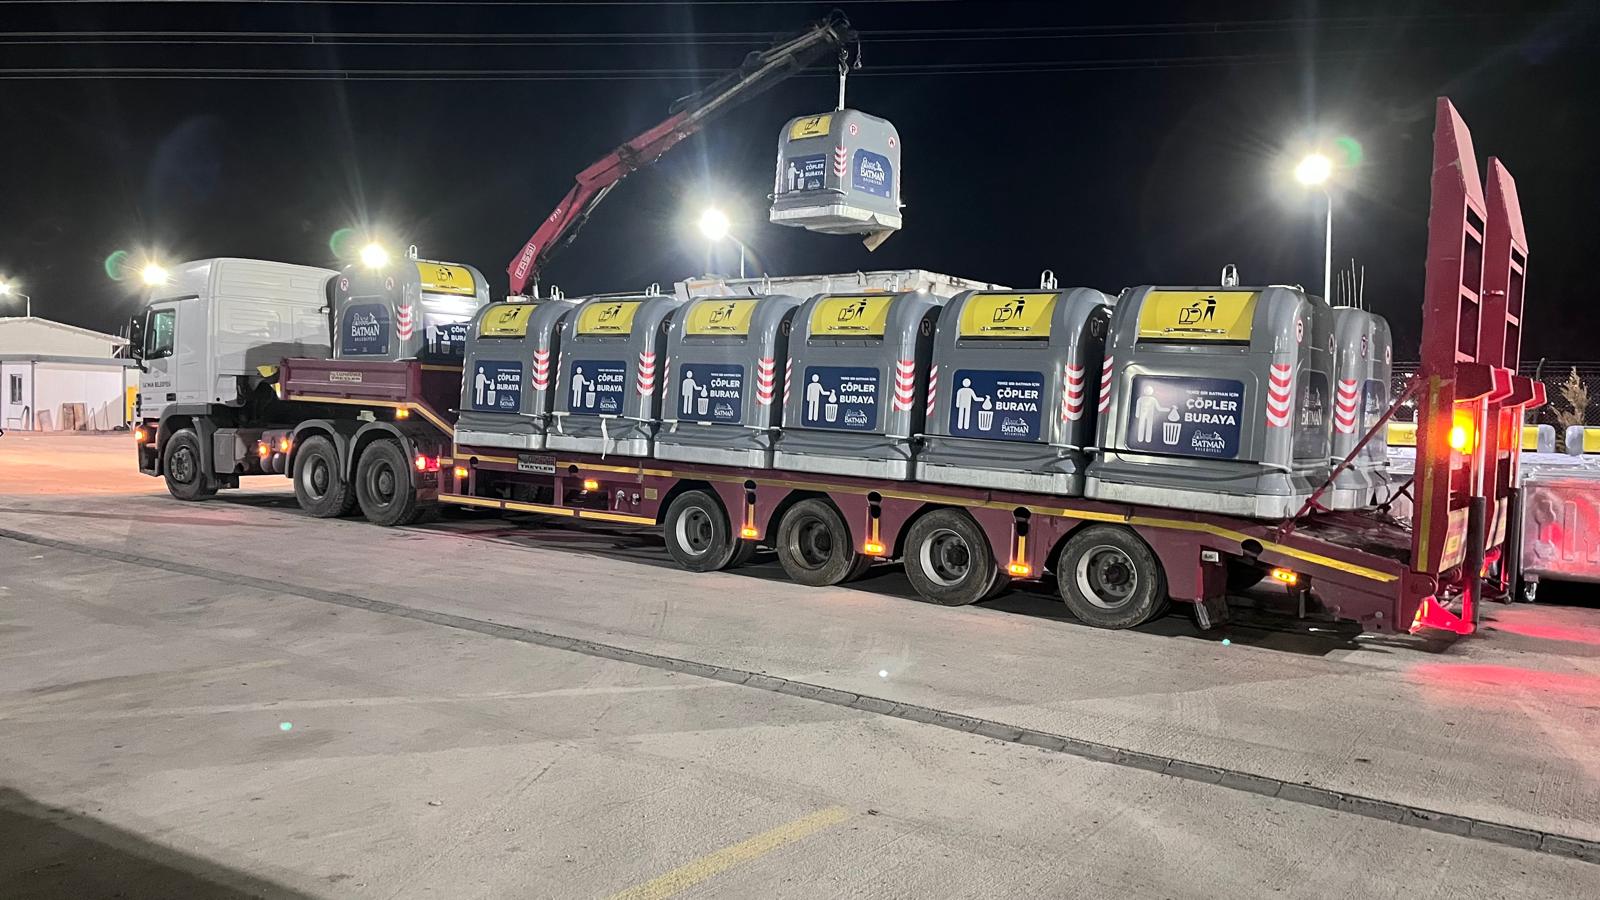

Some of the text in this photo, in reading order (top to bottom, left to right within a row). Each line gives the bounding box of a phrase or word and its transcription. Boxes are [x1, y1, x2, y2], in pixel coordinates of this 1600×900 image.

[860, 168, 885, 182] BATMAN
[351, 324, 380, 337] BATMAN
[497, 372, 520, 382] ÇÖPLER
[597, 373, 624, 383] ÇÖPLER
[710, 377, 740, 388] ÇÖPLER
[496, 383, 519, 391] BURAYA
[596, 384, 623, 392] BURAYA
[840, 381, 875, 393] ÇÖPLER
[710, 389, 740, 399] BURAYA
[996, 387, 1040, 400] ÇÖPLER
[839, 394, 875, 405] BURAYA
[1186, 396, 1238, 412] ÇÖPLER
[995, 401, 1038, 412] BURAYA
[844, 416, 868, 424] BATMAN
[1184, 412, 1237, 426] BURAYA
[1001, 424, 1030, 434] BATMAN
[1191, 438, 1226, 450] BATMAN
